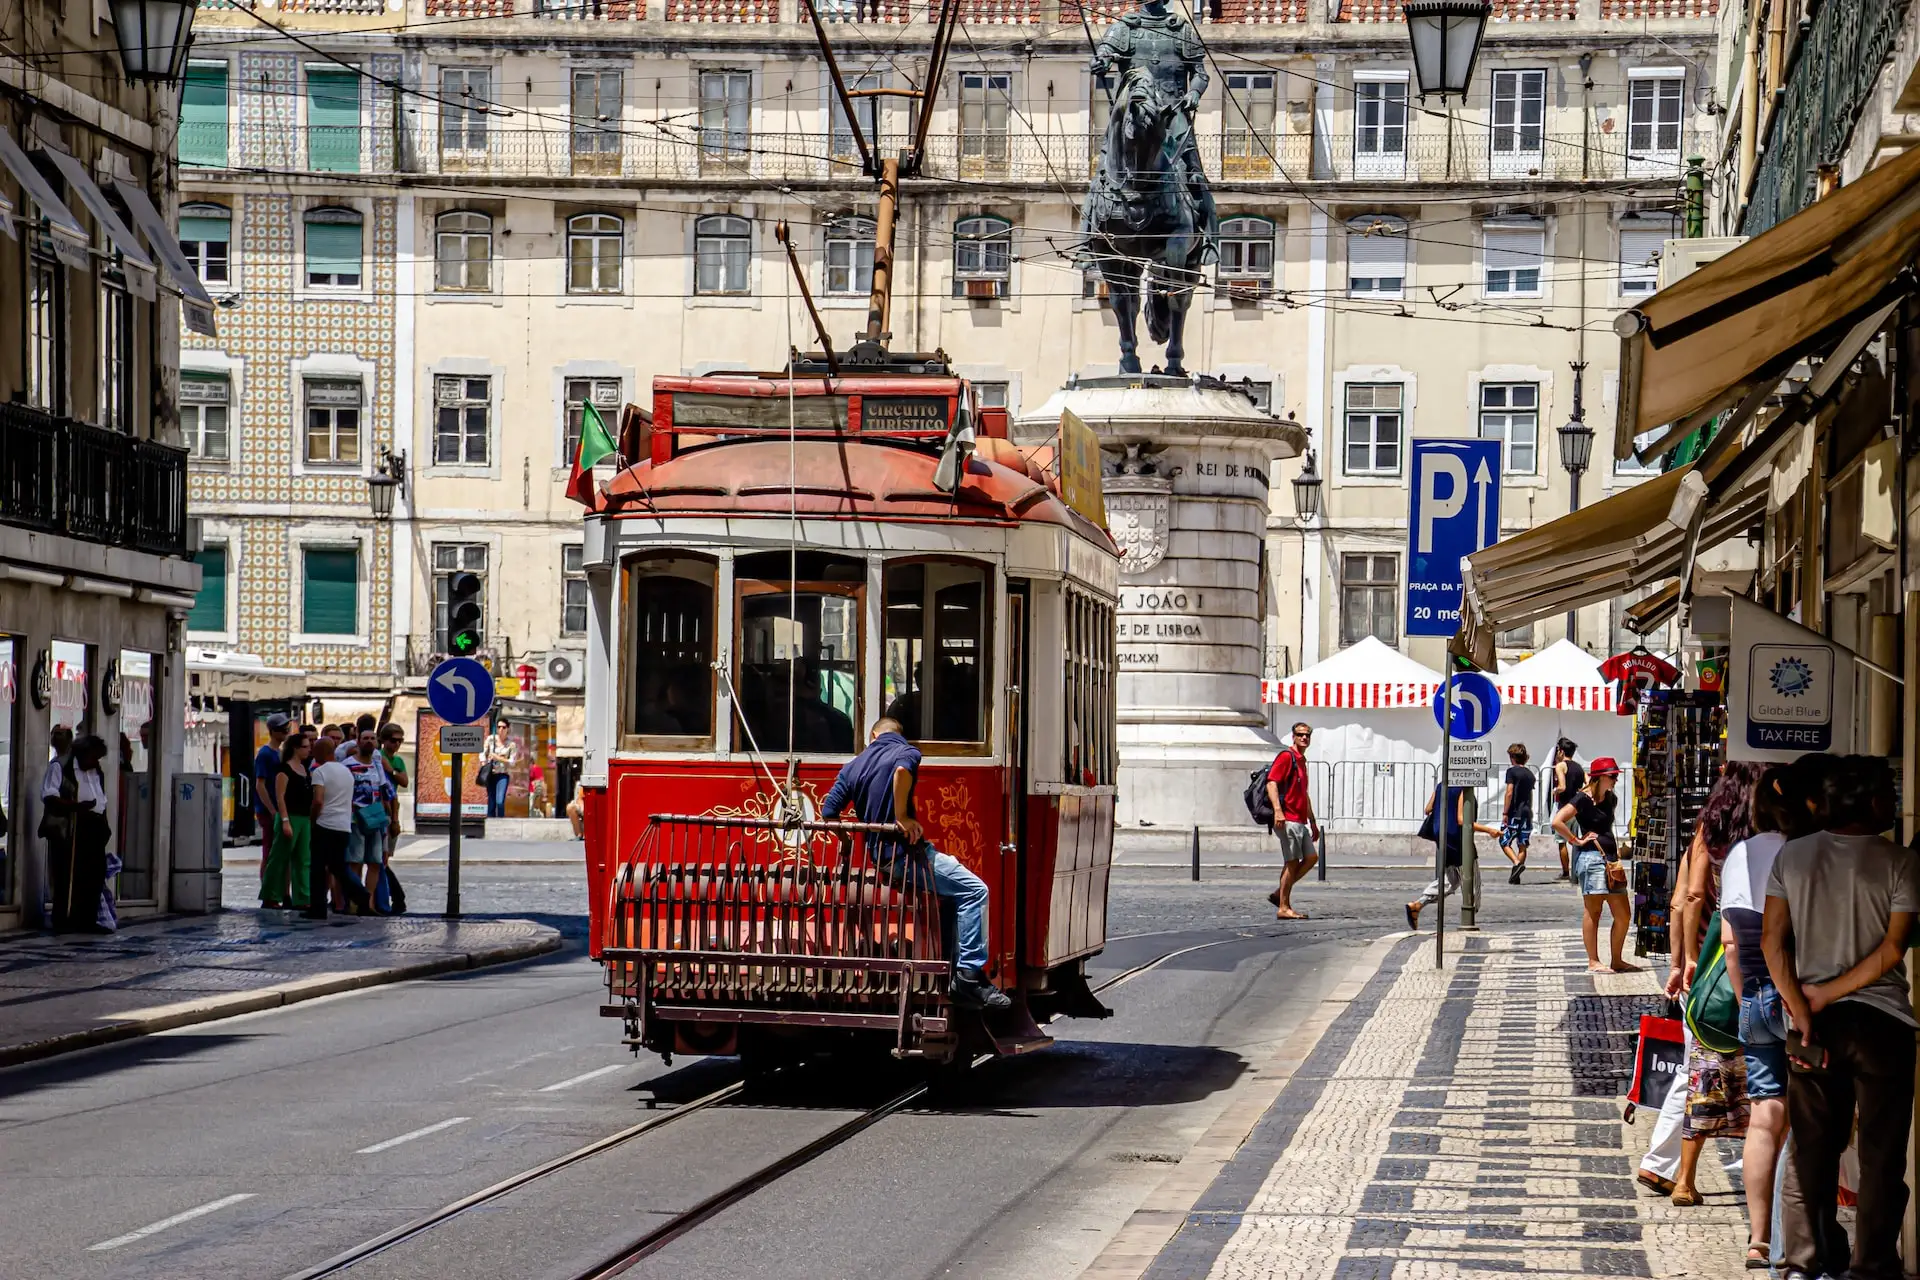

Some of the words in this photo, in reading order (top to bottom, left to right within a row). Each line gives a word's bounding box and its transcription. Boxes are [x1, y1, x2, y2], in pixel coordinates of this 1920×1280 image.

[868, 404, 938, 417] CIRCUITO
[866, 416, 945, 430] TURÍSTICO
[1196, 464, 1217, 476] REI
[1225, 465, 1239, 477] DE
[1418, 453, 1468, 553] P
[1409, 583, 1438, 592] PRAÇA
[1441, 583, 1453, 591] DA
[1136, 590, 1187, 609] JOÃO
[1197, 594, 1203, 608] I
[1413, 606, 1431, 619] 20
[1437, 608, 1460, 620] me
[1133, 624, 1150, 636] DE
[1156, 624, 1202, 636] LISBOA
[1622, 658, 1657, 671] RONALDO
[1635, 671, 1655, 690] 7
[1758, 704, 1794, 716] Global
[1796, 706, 1821, 717] Blue
[1758, 728, 1784, 742] TAX
[1786, 730, 1820, 743] FREE
[1453, 744, 1483, 752] EXCEPTO
[1449, 756, 1488, 765] RESIDENTES
